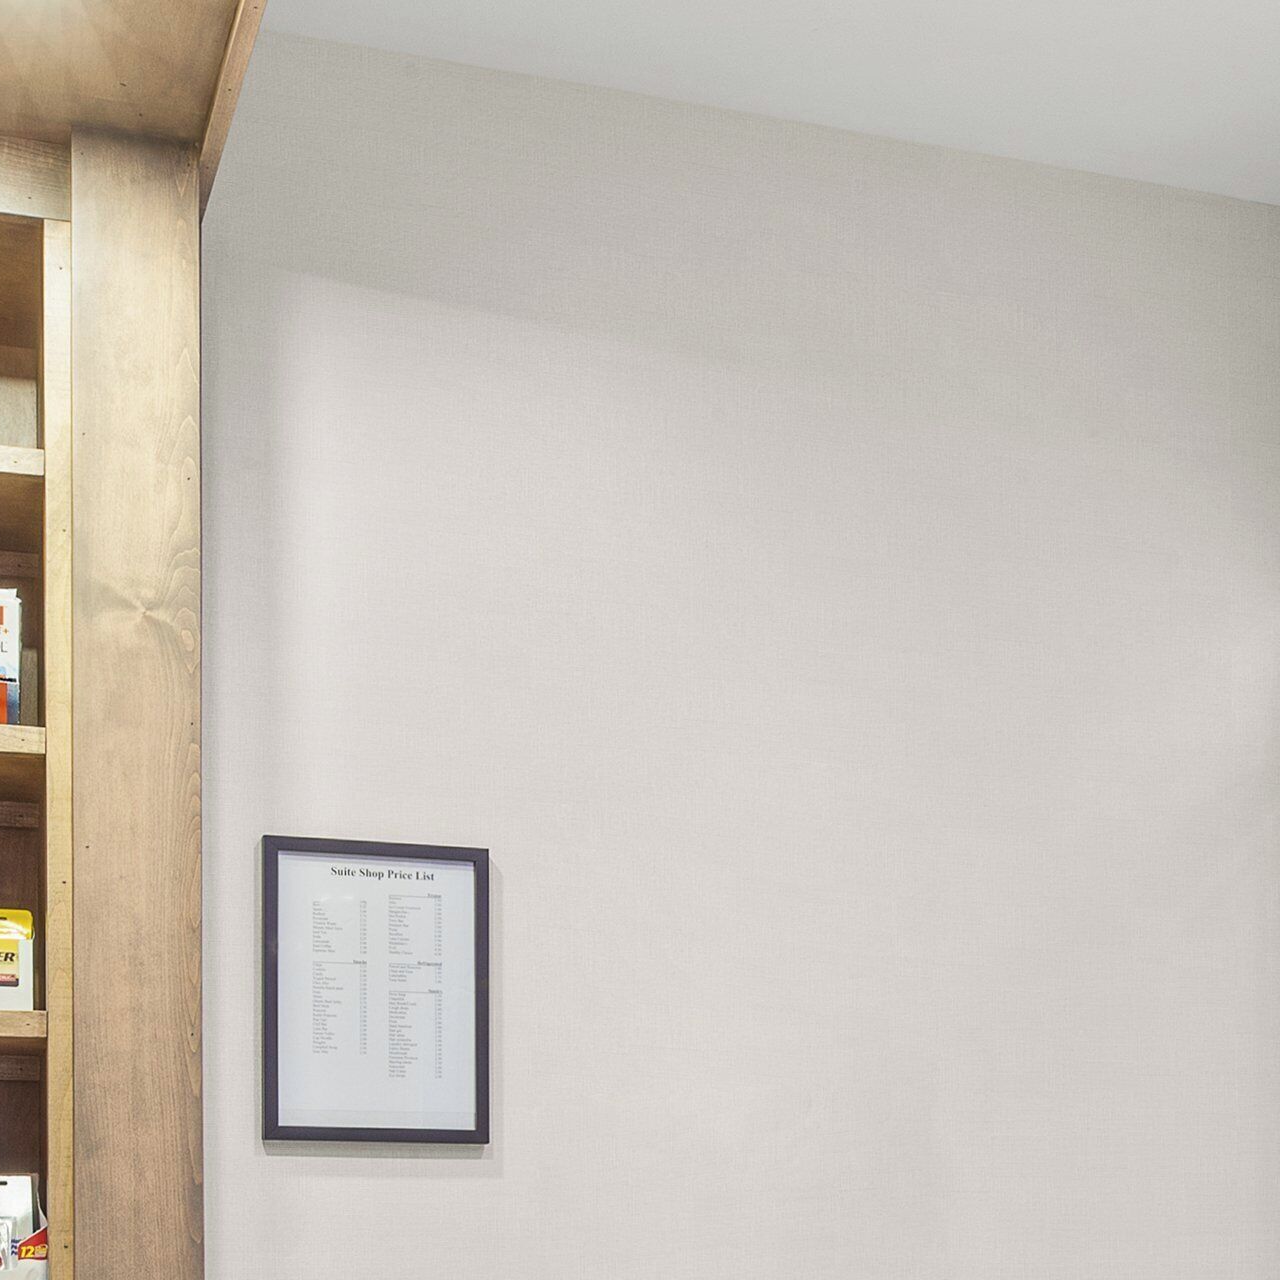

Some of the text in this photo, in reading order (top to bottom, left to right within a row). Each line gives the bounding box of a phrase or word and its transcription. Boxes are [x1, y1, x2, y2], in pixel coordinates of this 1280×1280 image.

[331, 867, 434, 882] Suite Shop Price List
[20, 1246, 34, 1258] 12
